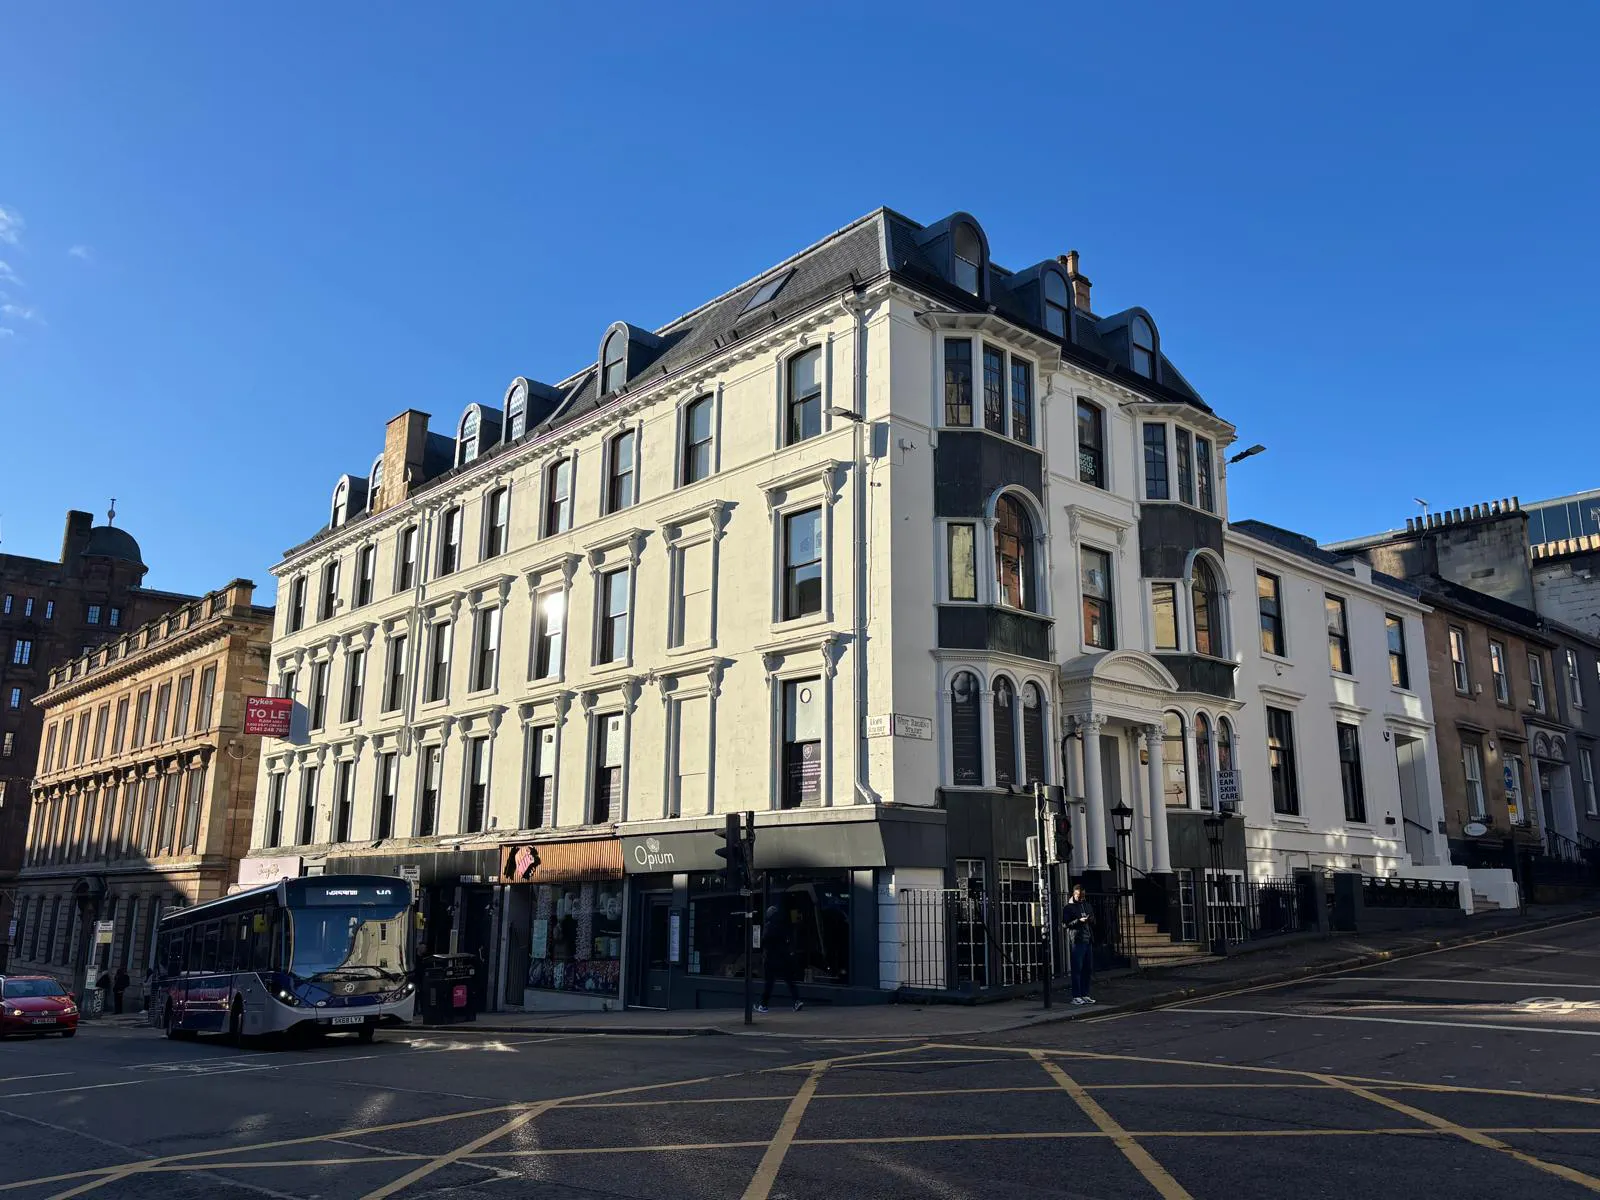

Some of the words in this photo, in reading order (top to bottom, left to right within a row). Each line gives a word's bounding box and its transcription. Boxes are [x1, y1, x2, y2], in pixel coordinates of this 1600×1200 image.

[249, 708, 267, 718] TO
[270, 710, 290, 719] LET
[634, 845, 675, 871] Opium
